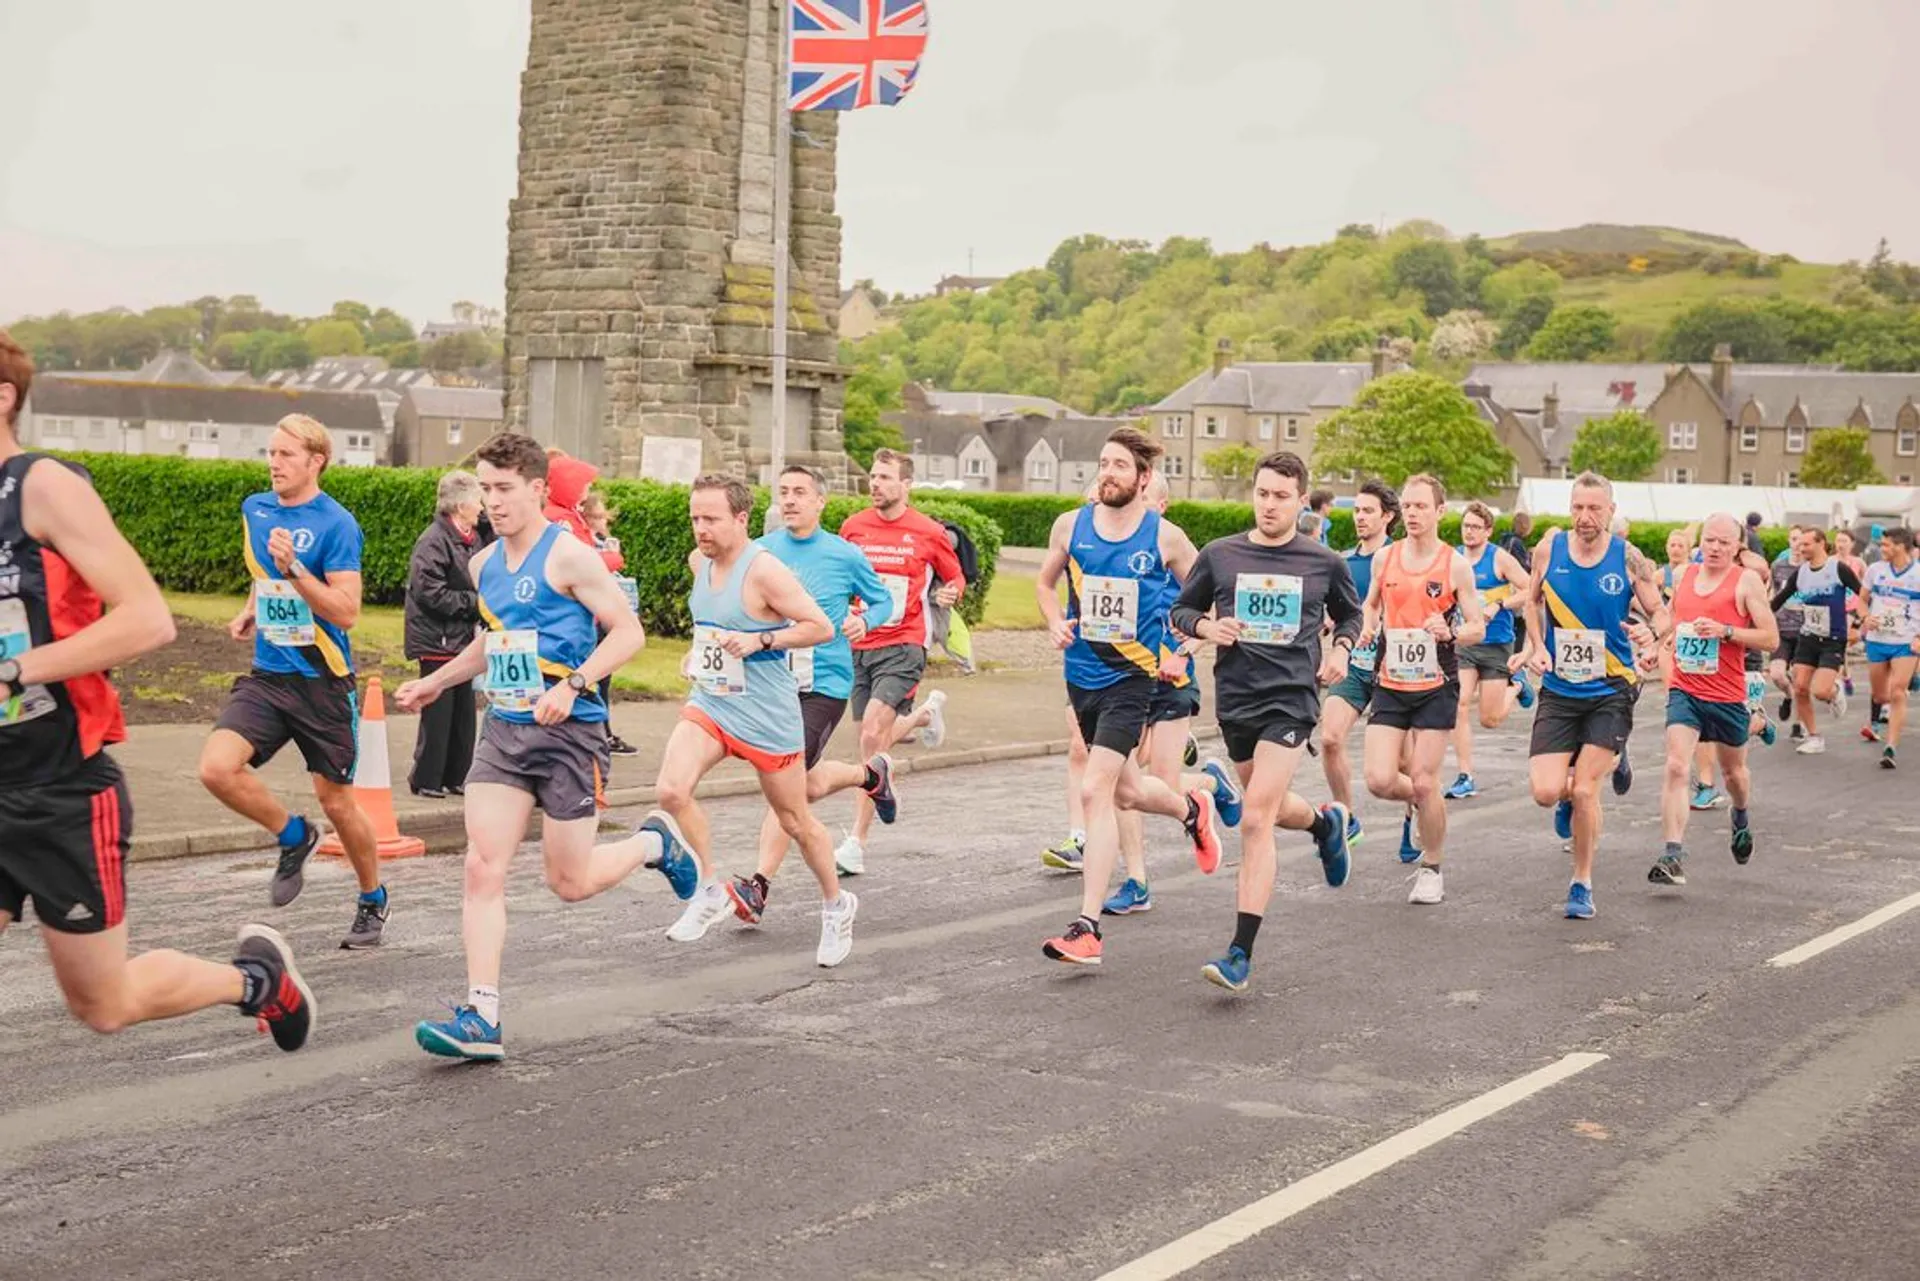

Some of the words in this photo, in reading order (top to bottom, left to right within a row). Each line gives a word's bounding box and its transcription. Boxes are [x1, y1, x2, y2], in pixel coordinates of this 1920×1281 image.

[266, 598, 298, 621] 664
[1092, 595, 1124, 619] 184
[1248, 592, 1287, 618] 805
[1398, 644, 1426, 663] 169
[1563, 644, 1594, 663] 234
[1682, 637, 1709, 656] 752
[702, 646, 724, 671] 58
